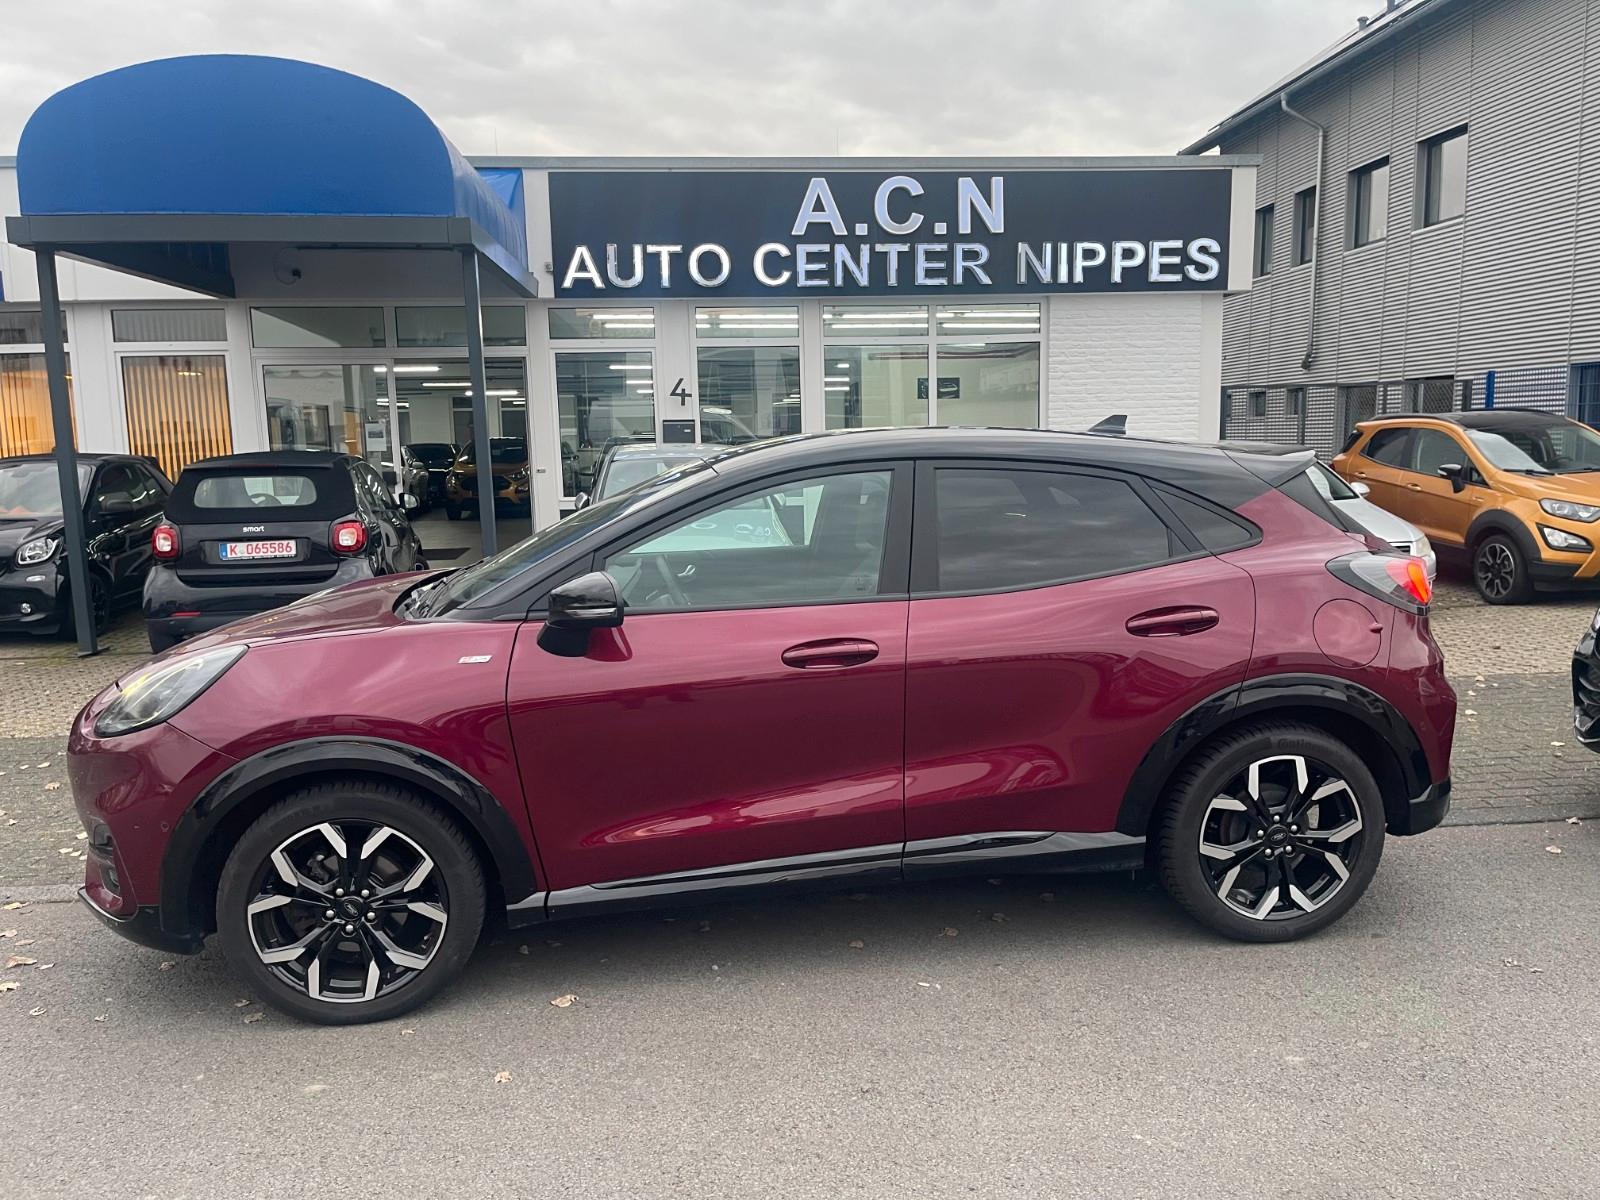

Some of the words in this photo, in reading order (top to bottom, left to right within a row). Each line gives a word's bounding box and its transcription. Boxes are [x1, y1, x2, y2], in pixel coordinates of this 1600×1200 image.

[791, 175, 1005, 236] A.C.N
[561, 242, 732, 289] AUTO
[753, 242, 993, 287] CENTER
[1016, 237, 1222, 285] NIPPES
[669, 377, 693, 407] 4
[242, 525, 265, 533] smart
[229, 544, 238, 556] K
[246, 541, 293, 555] 065586
